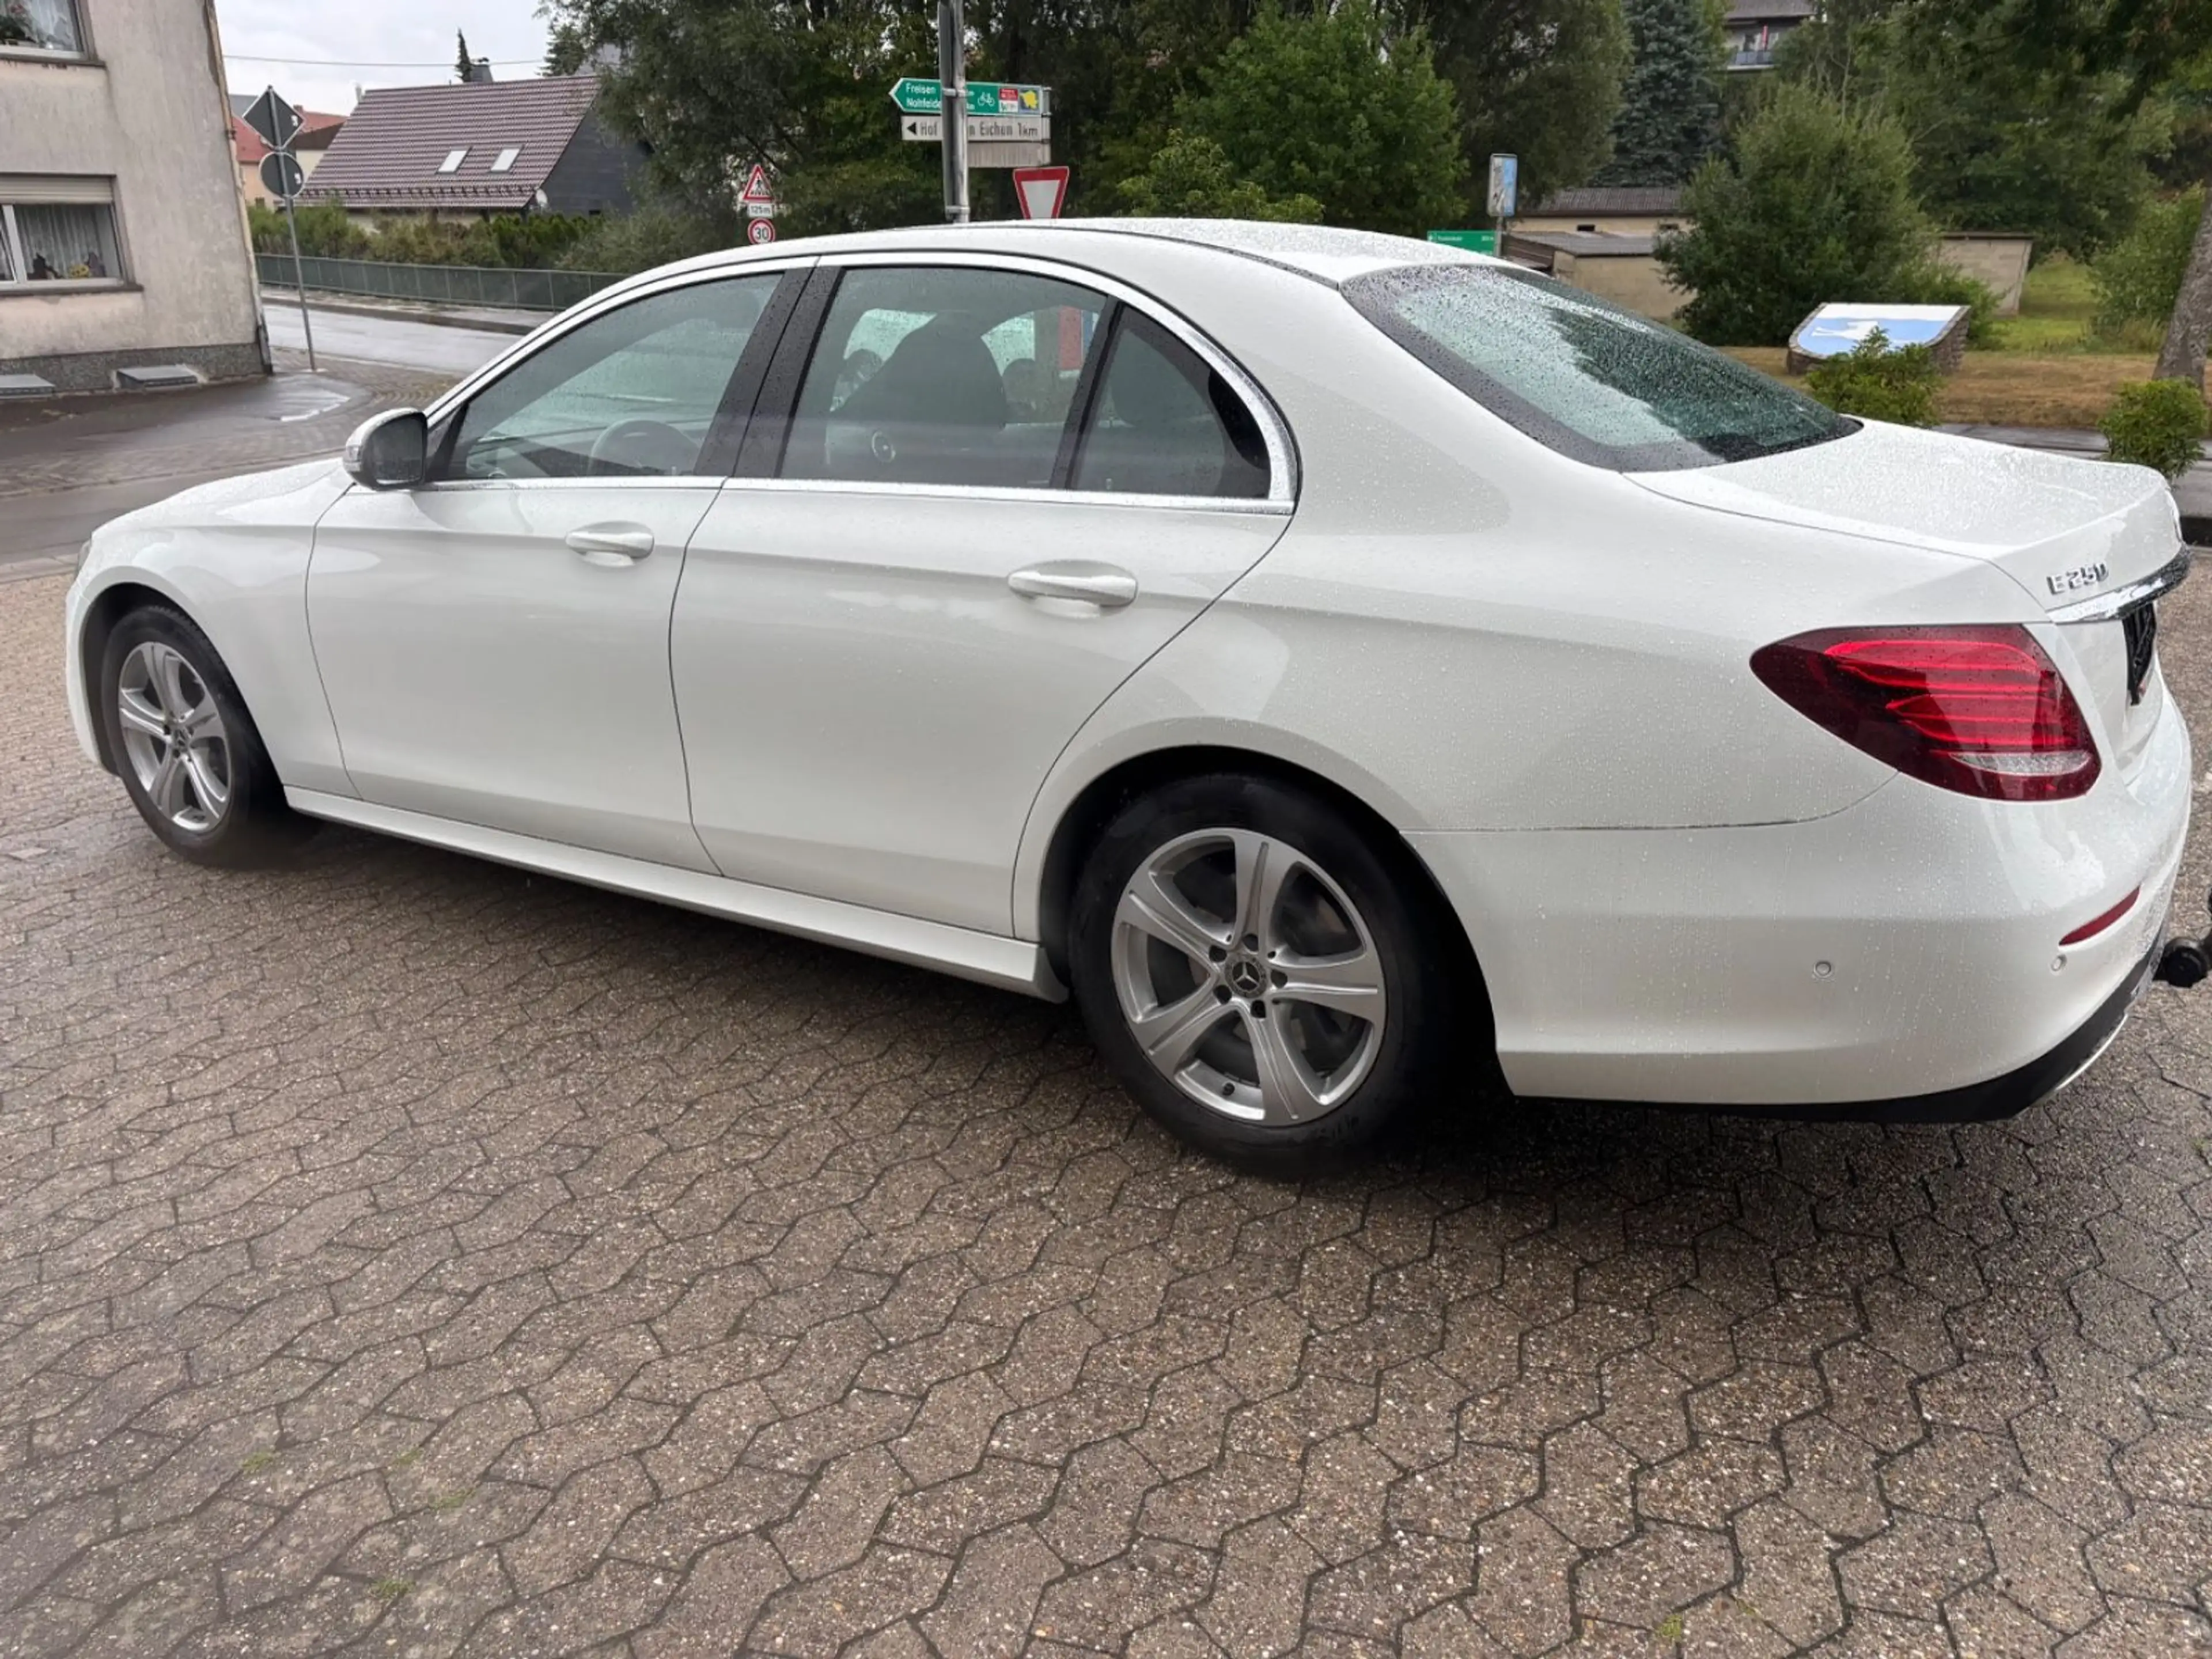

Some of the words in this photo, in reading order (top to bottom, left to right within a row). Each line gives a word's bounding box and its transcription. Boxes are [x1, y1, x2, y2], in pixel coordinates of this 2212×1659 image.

[905, 82, 936, 94] Freisen
[921, 121, 938, 136] Hof
[754, 227, 769, 240] 30
